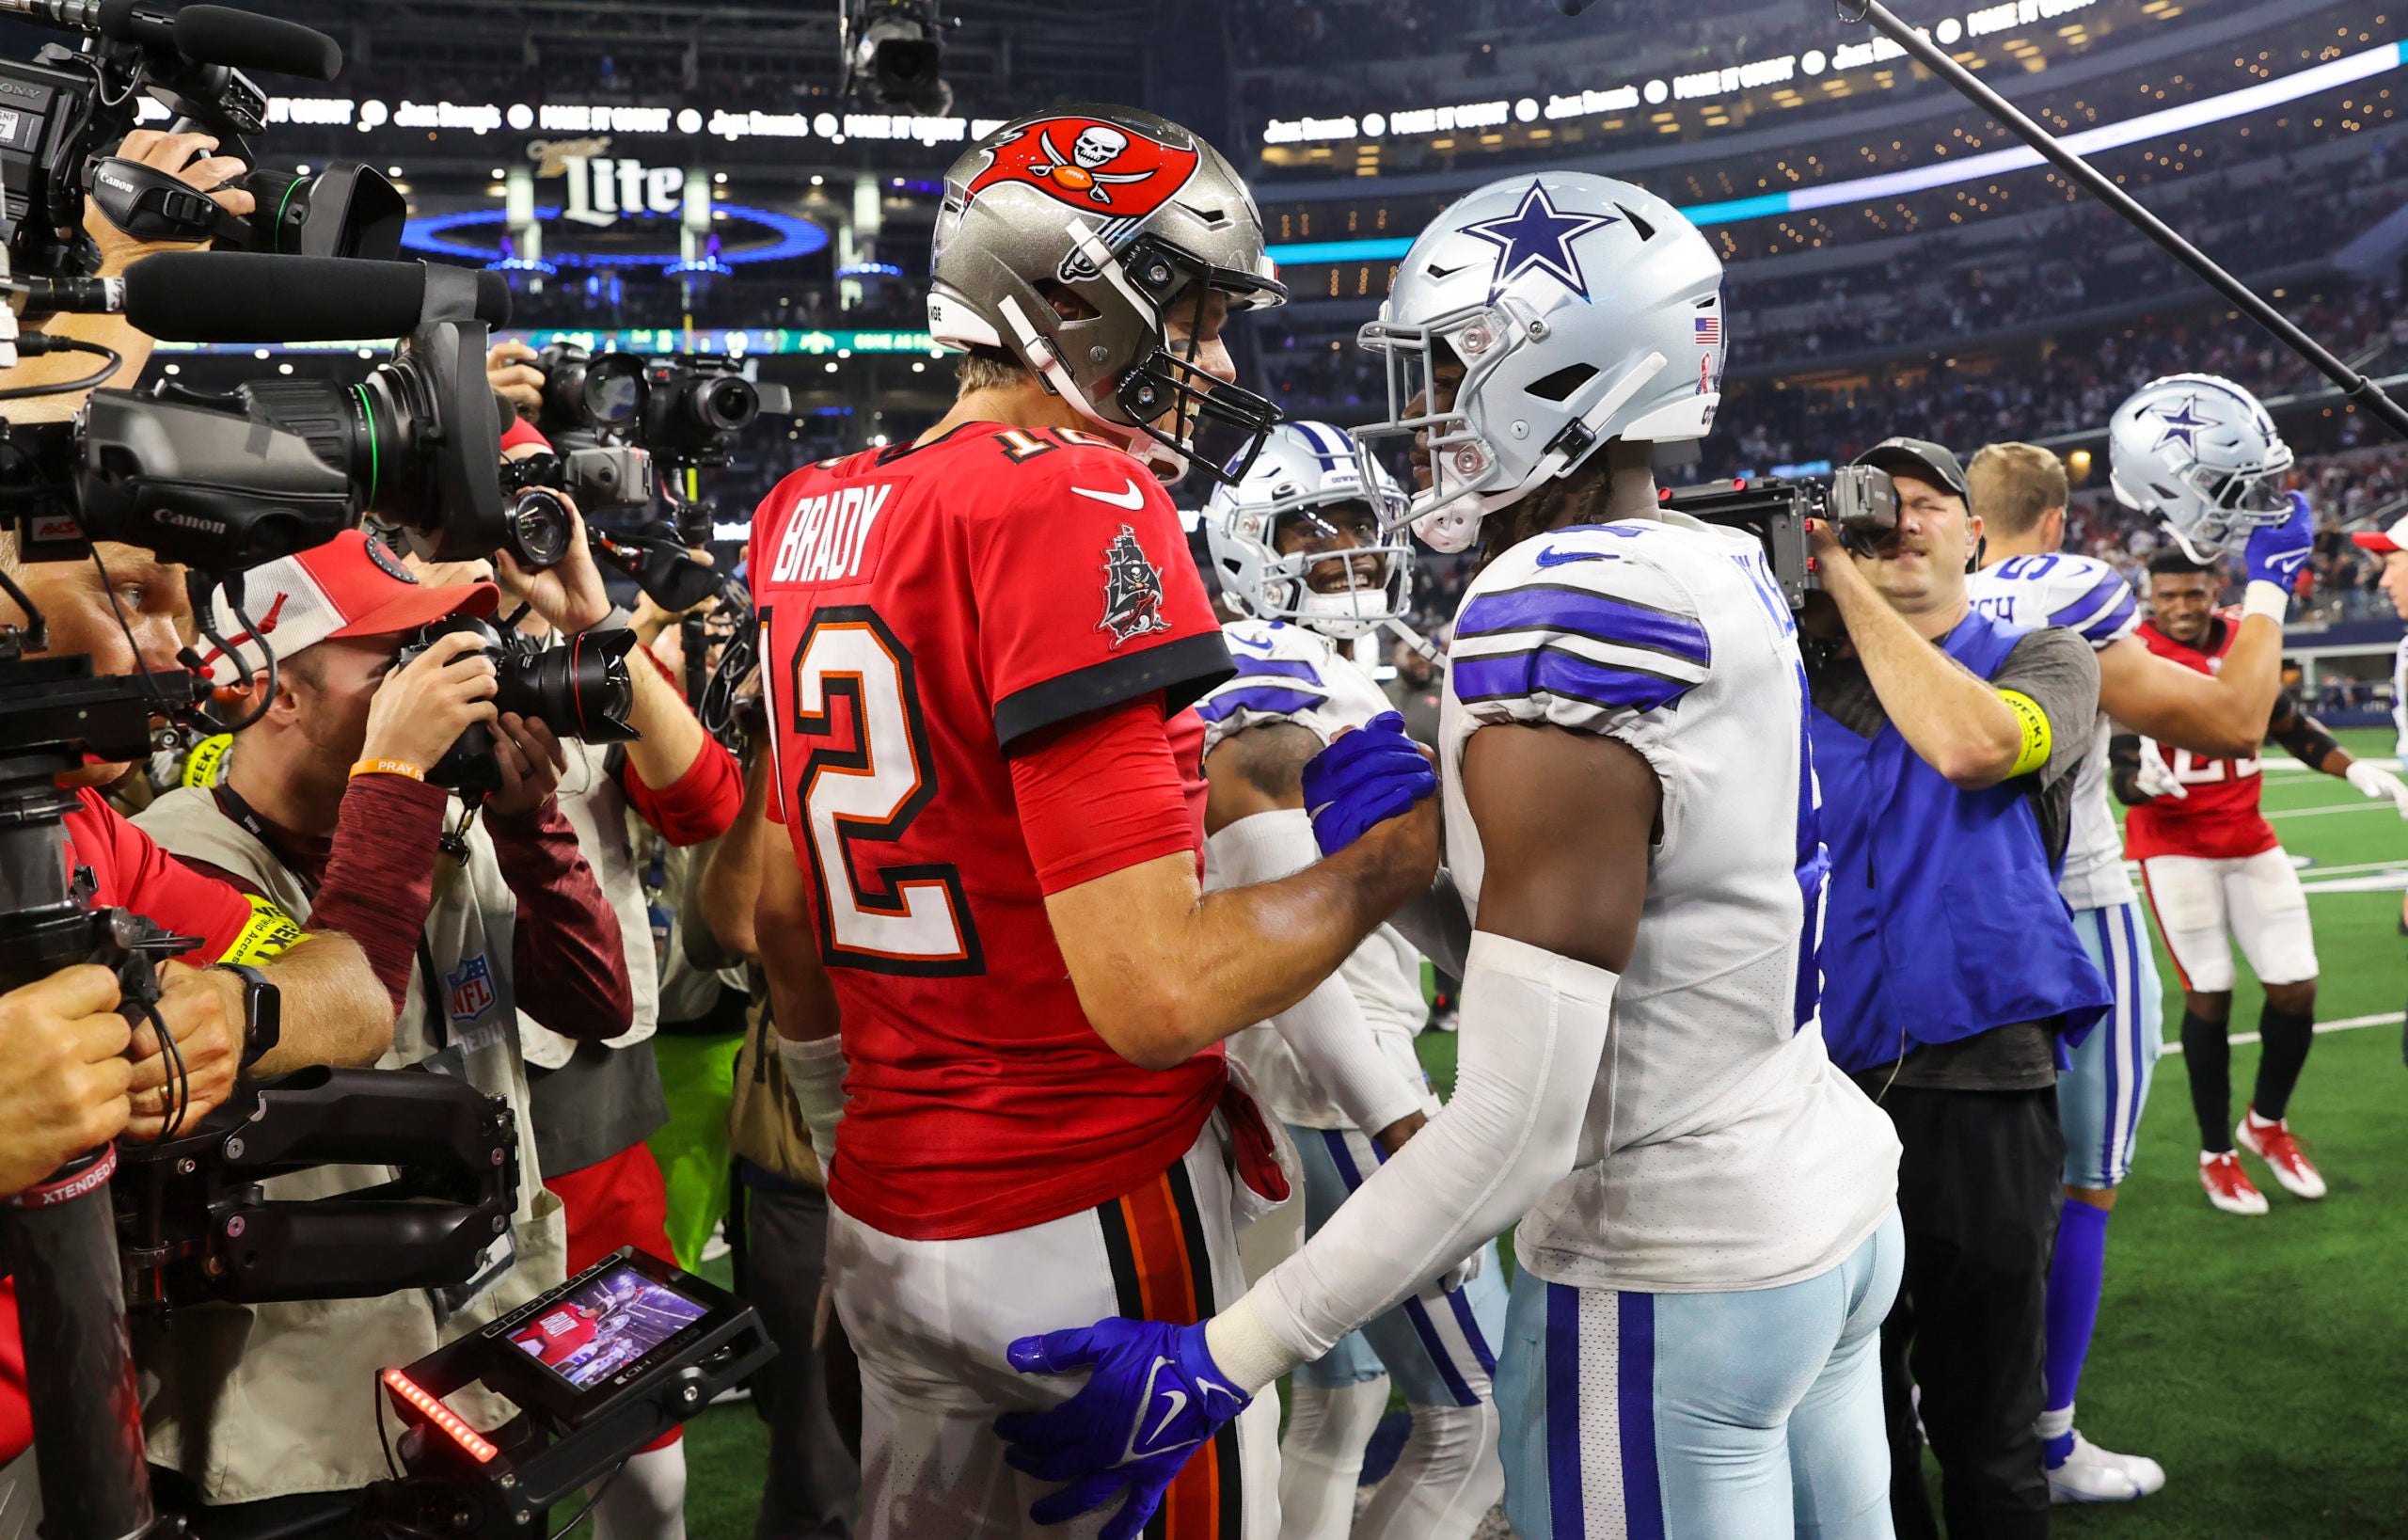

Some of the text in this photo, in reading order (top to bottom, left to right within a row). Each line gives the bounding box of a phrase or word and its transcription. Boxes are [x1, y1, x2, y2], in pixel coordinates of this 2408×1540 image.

[0, 83, 40, 100] ONY
[100, 172, 135, 193] Canon
[560, 155, 684, 227] Lite
[153, 508, 227, 535] Canon
[770, 484, 892, 582] BRADY
[1970, 595, 2016, 624] CH
[377, 760, 414, 775] PRAY
[231, 929, 259, 965] Acces
[452, 979, 491, 1015] NFL
[43, 1162, 111, 1204] XTENDED
